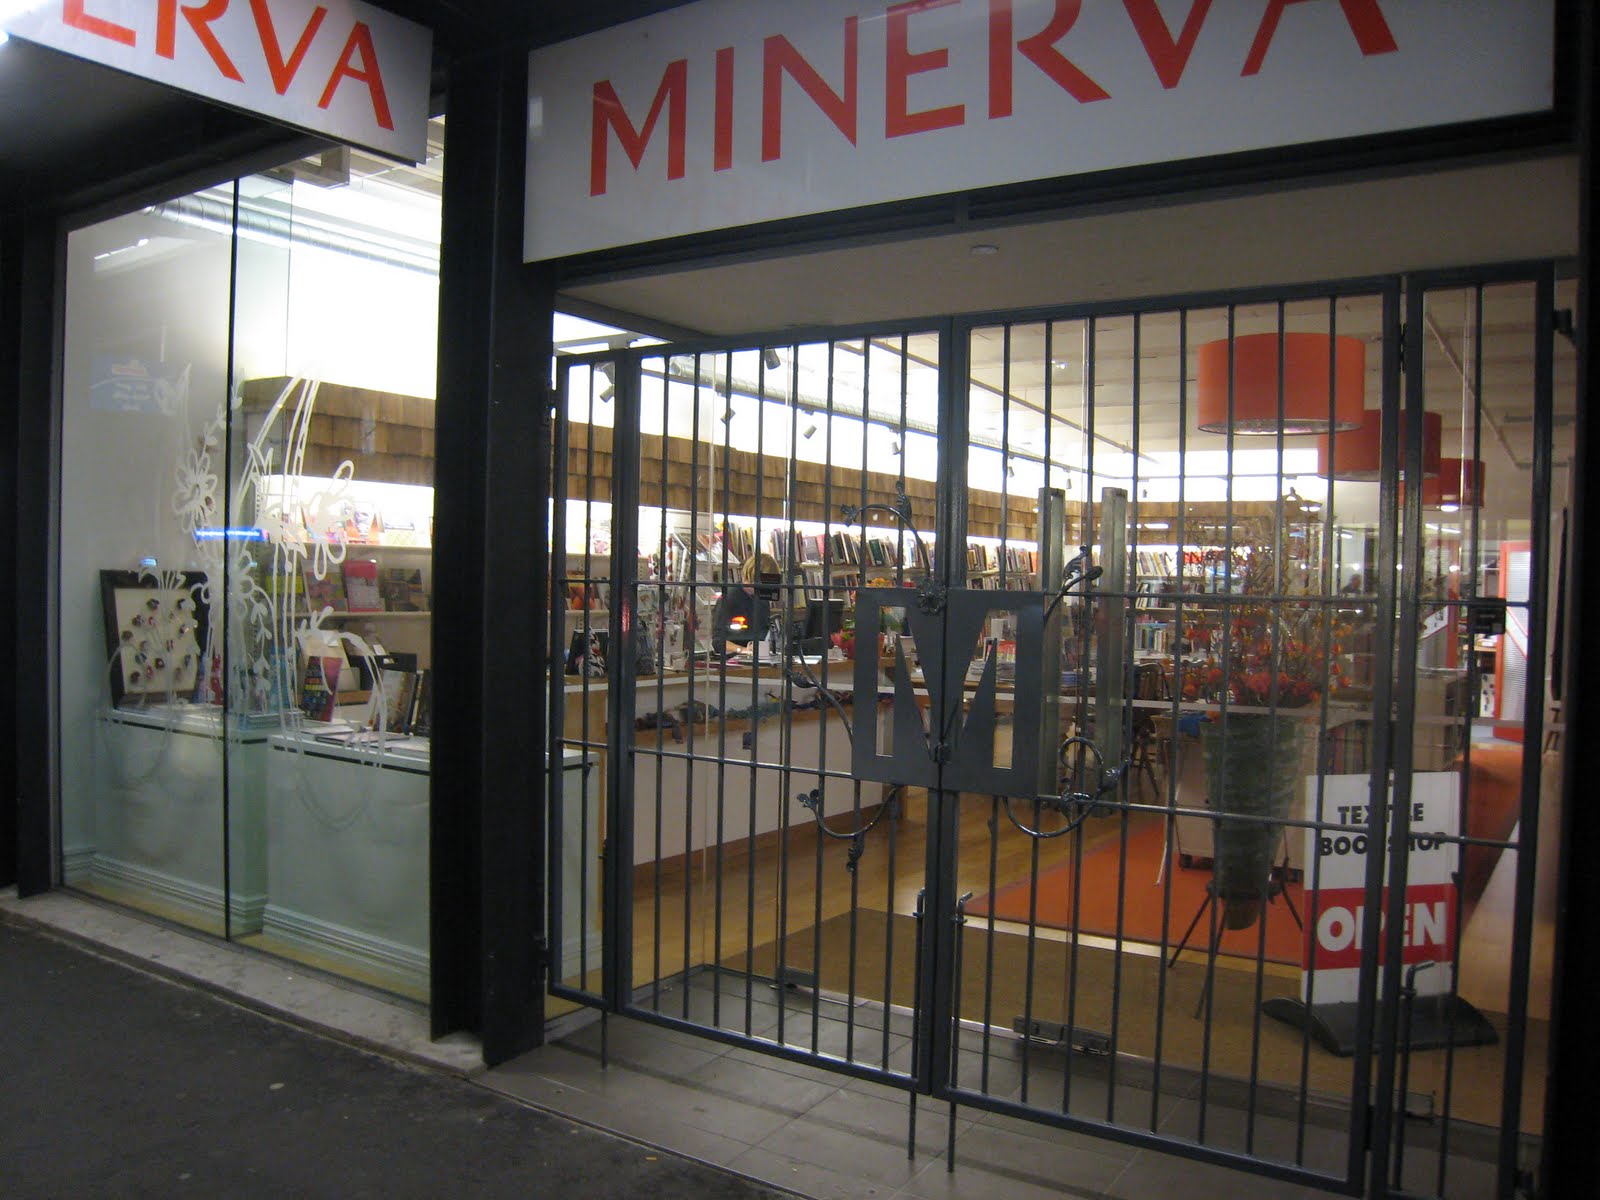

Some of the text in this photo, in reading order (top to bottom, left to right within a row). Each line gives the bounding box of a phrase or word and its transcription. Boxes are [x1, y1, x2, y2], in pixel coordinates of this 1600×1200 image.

[62, 0, 395, 131] RVA
[589, 0, 1399, 197] MINERVA
[1319, 831, 1446, 857] BOOOP
[1337, 802, 1424, 825] TEXTE
